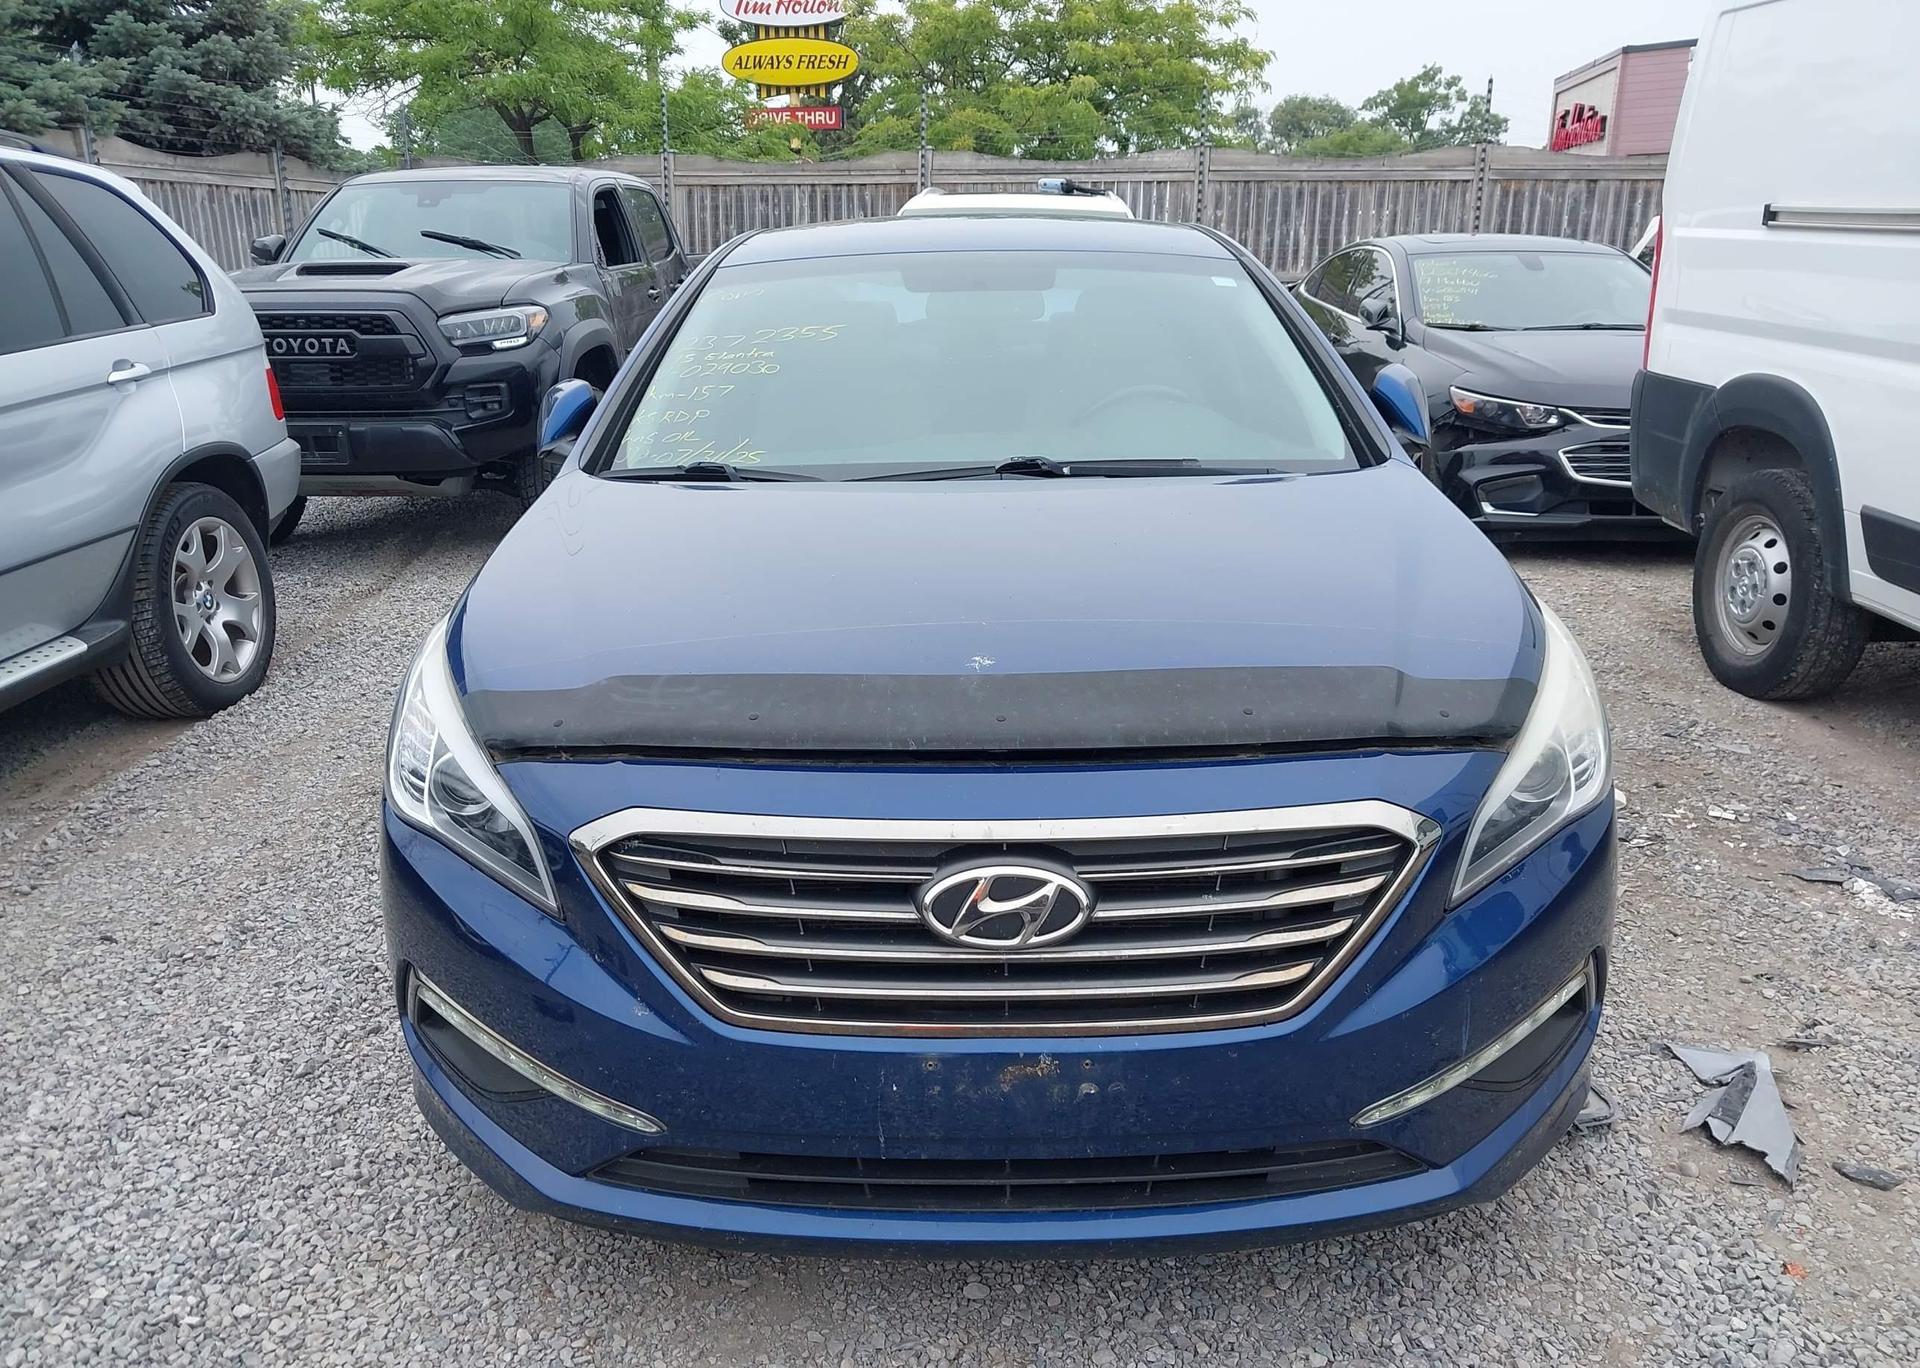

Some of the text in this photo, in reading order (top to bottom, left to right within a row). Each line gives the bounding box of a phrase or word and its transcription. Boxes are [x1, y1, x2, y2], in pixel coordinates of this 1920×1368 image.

[732, 54, 850, 70] ALWAYS FRESH
[796, 111, 836, 125] THRU
[704, 347, 775, 361] Elantra
